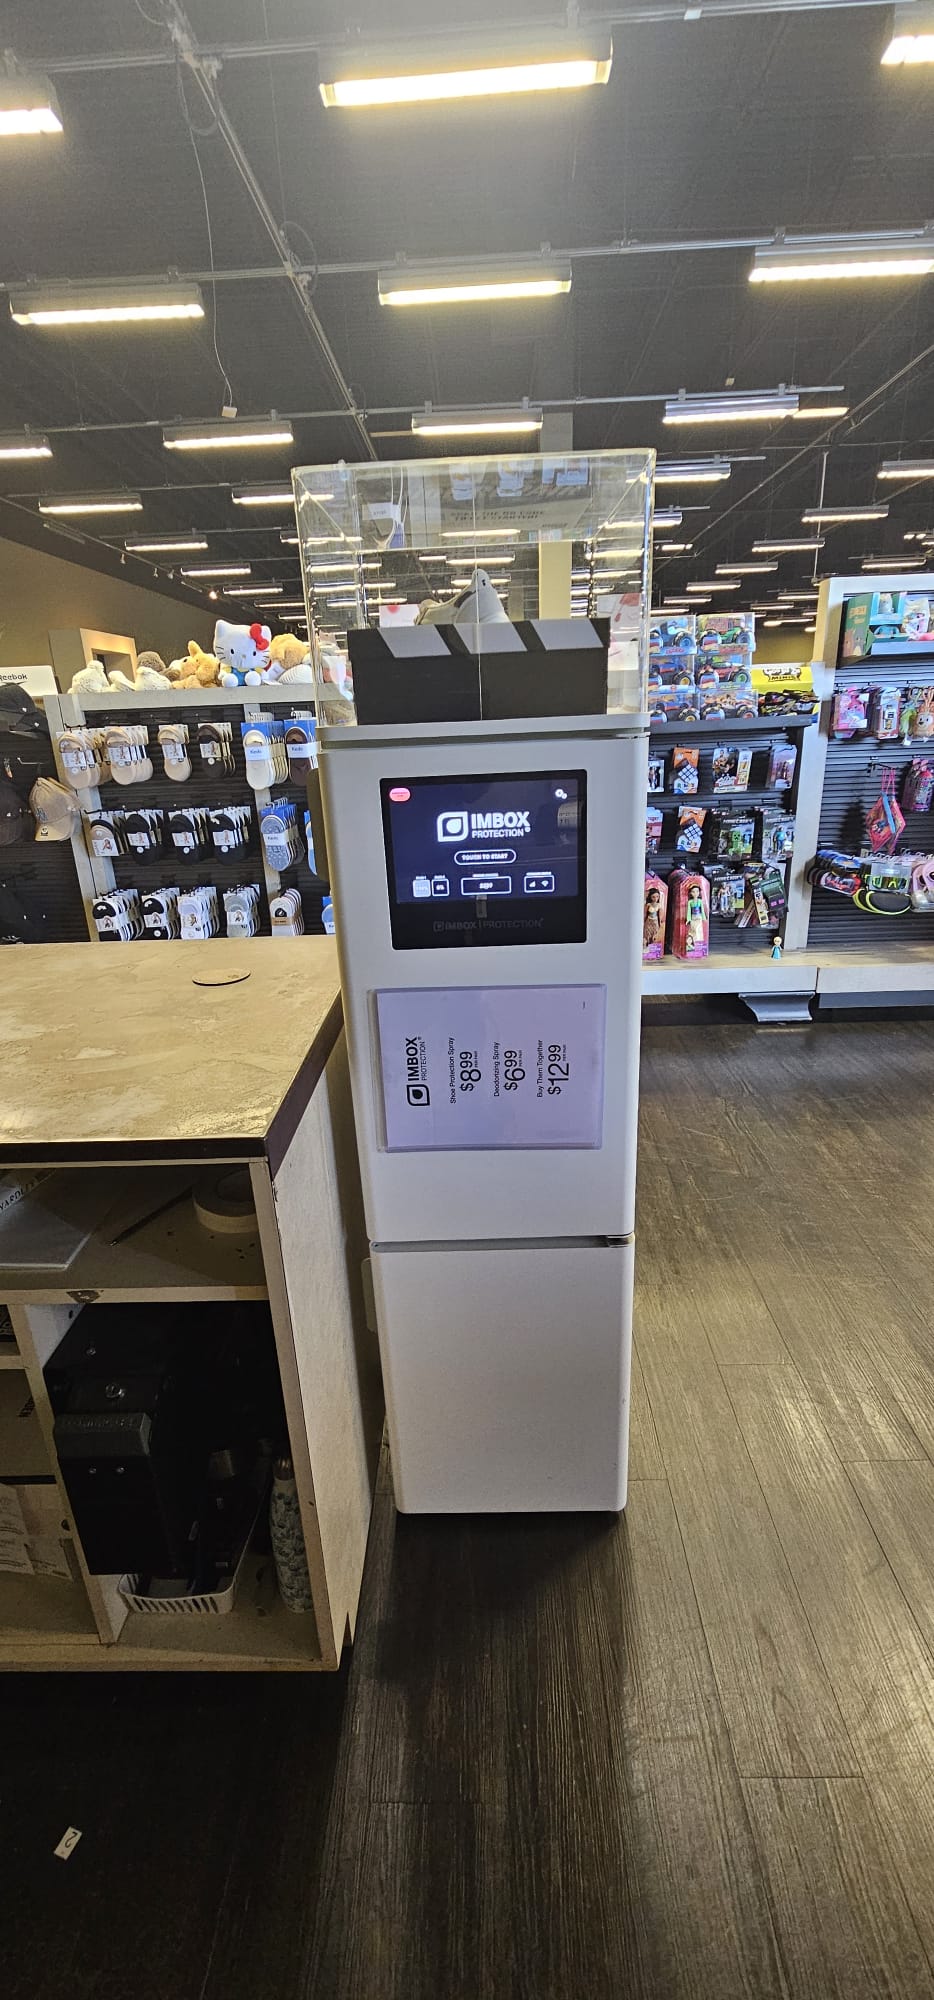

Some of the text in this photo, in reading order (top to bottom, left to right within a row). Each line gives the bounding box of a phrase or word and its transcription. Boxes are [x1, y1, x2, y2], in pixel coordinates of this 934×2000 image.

[471, 811, 531, 829] IMBOX
[471, 828, 525, 839] PROTECTION
[445, 919, 542, 930] IMBOX PROTECTION
[405, 1036, 420, 1082] IMBOX
[492, 1042, 500, 1060] Spray
[536, 1040, 544, 1067] Together
[420, 1041, 428, 1081] PROTECTION
[447, 1037, 457, 1104] Shoe Protection Spray
[537, 1086, 545, 1098] Buy
